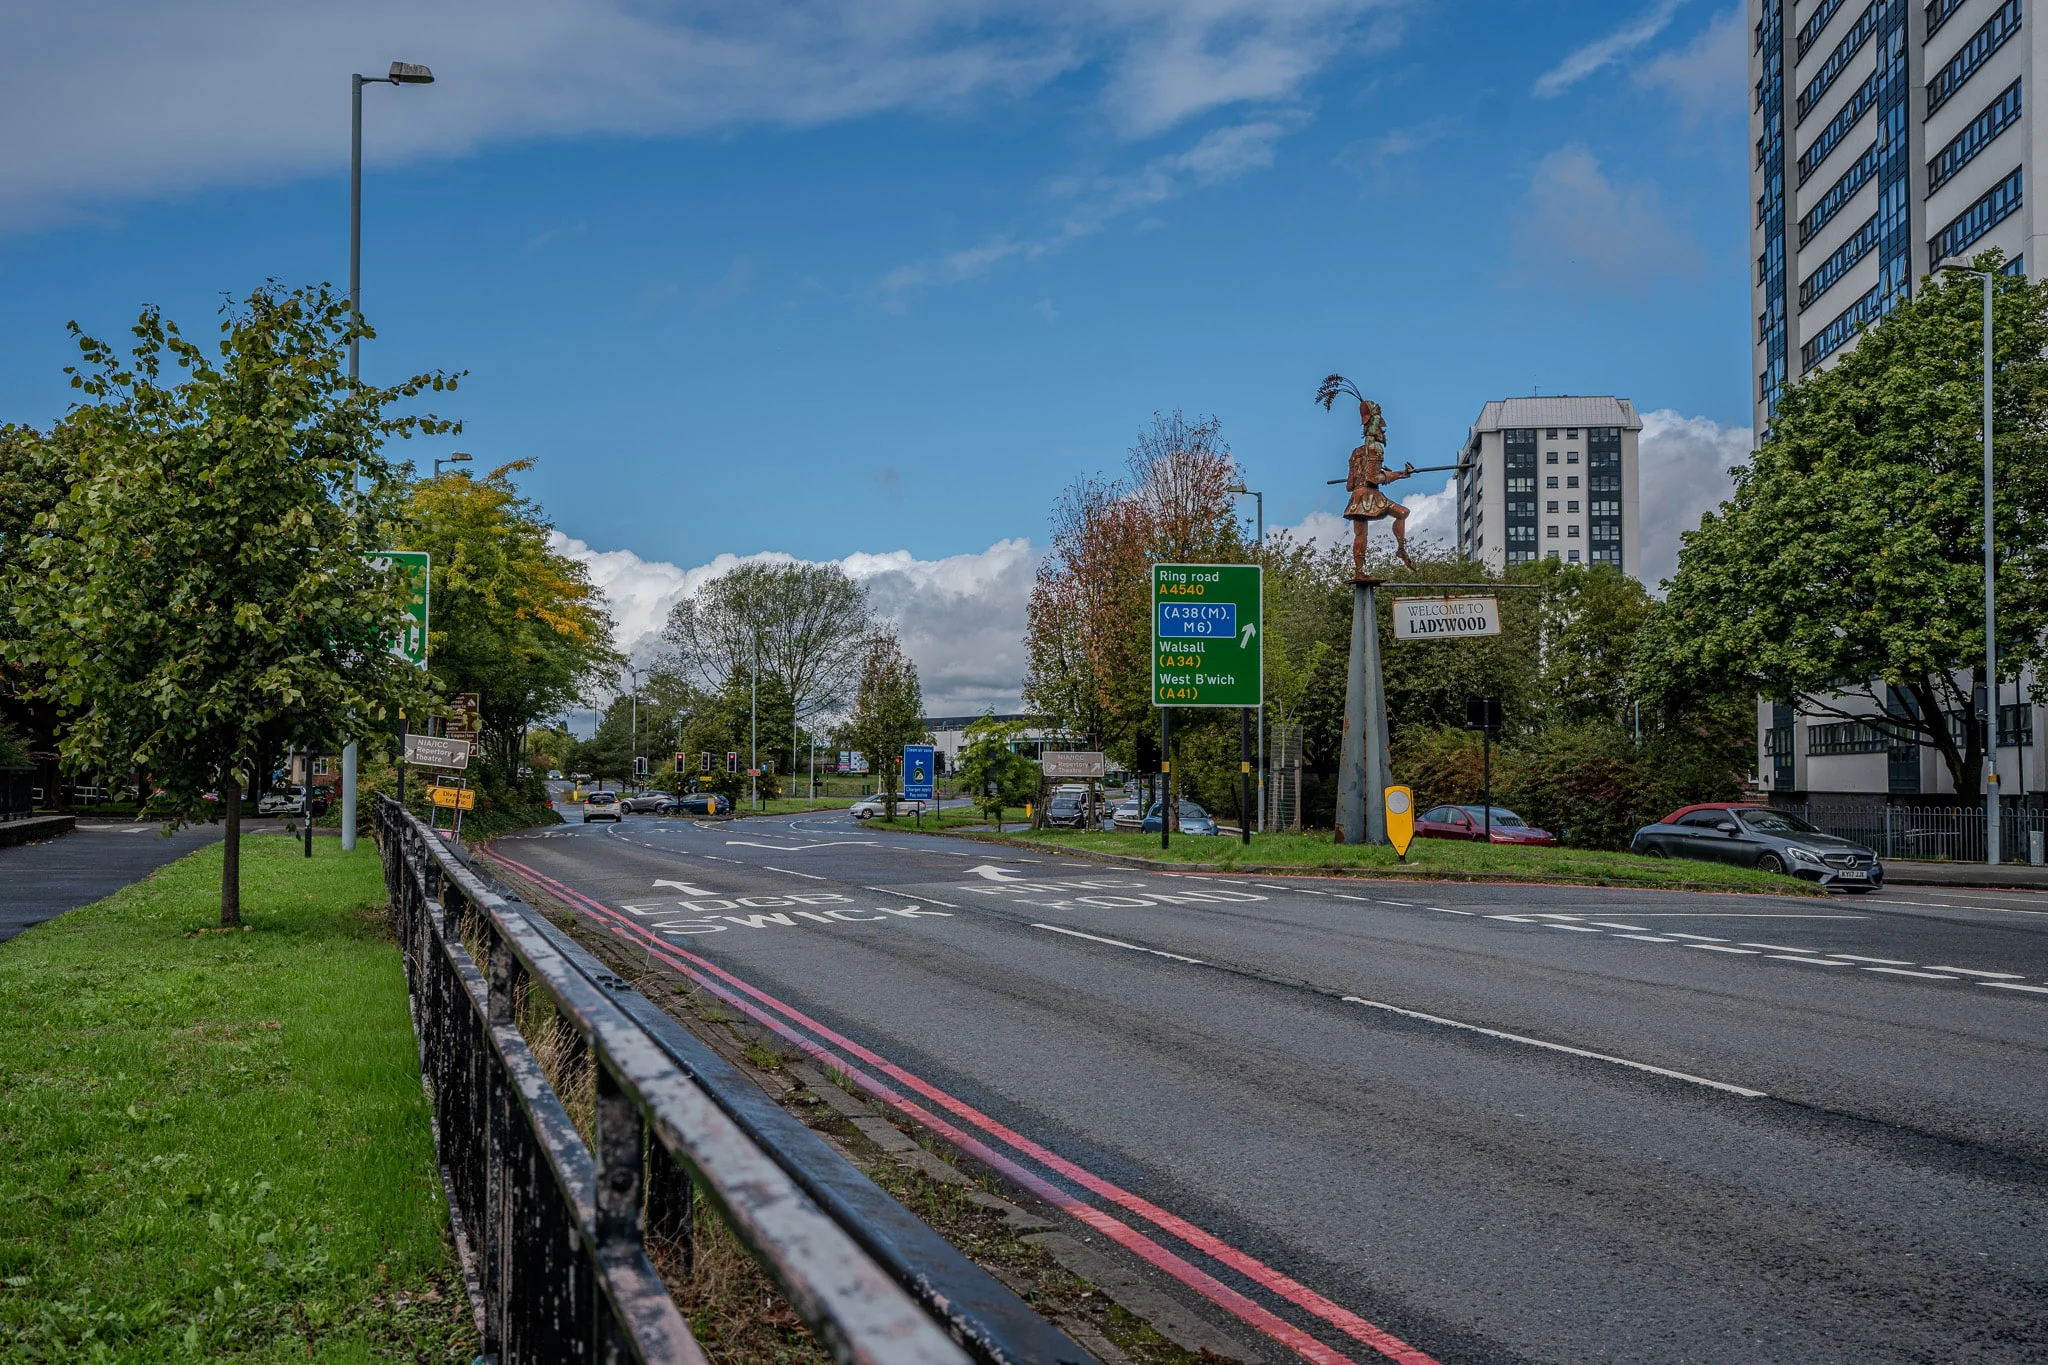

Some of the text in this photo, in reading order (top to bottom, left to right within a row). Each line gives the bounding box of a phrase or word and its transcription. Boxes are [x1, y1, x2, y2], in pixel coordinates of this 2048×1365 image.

[1159, 570, 1220, 584] Ring road
[1159, 584, 1204, 595] A4540
[1408, 603, 1484, 617] WELCOME TO
[1184, 622, 1212, 634] M6)
[1409, 616, 1487, 634] LADYWOOD
[1159, 641, 1205, 653] Walsall
[1159, 655, 1201, 668] (A34)
[1159, 673, 1235, 685] West B'wich
[1159, 687, 1198, 700] (A41)
[417, 739, 449, 749] NIA/ICC
[416, 746, 452, 757] Repertory
[416, 753, 442, 762] Theatre
[443, 791, 471, 800] Diveted
[957, 880, 1147, 895] RING
[621, 893, 856, 916] EDGB
[1011, 890, 1269, 909] ROAD
